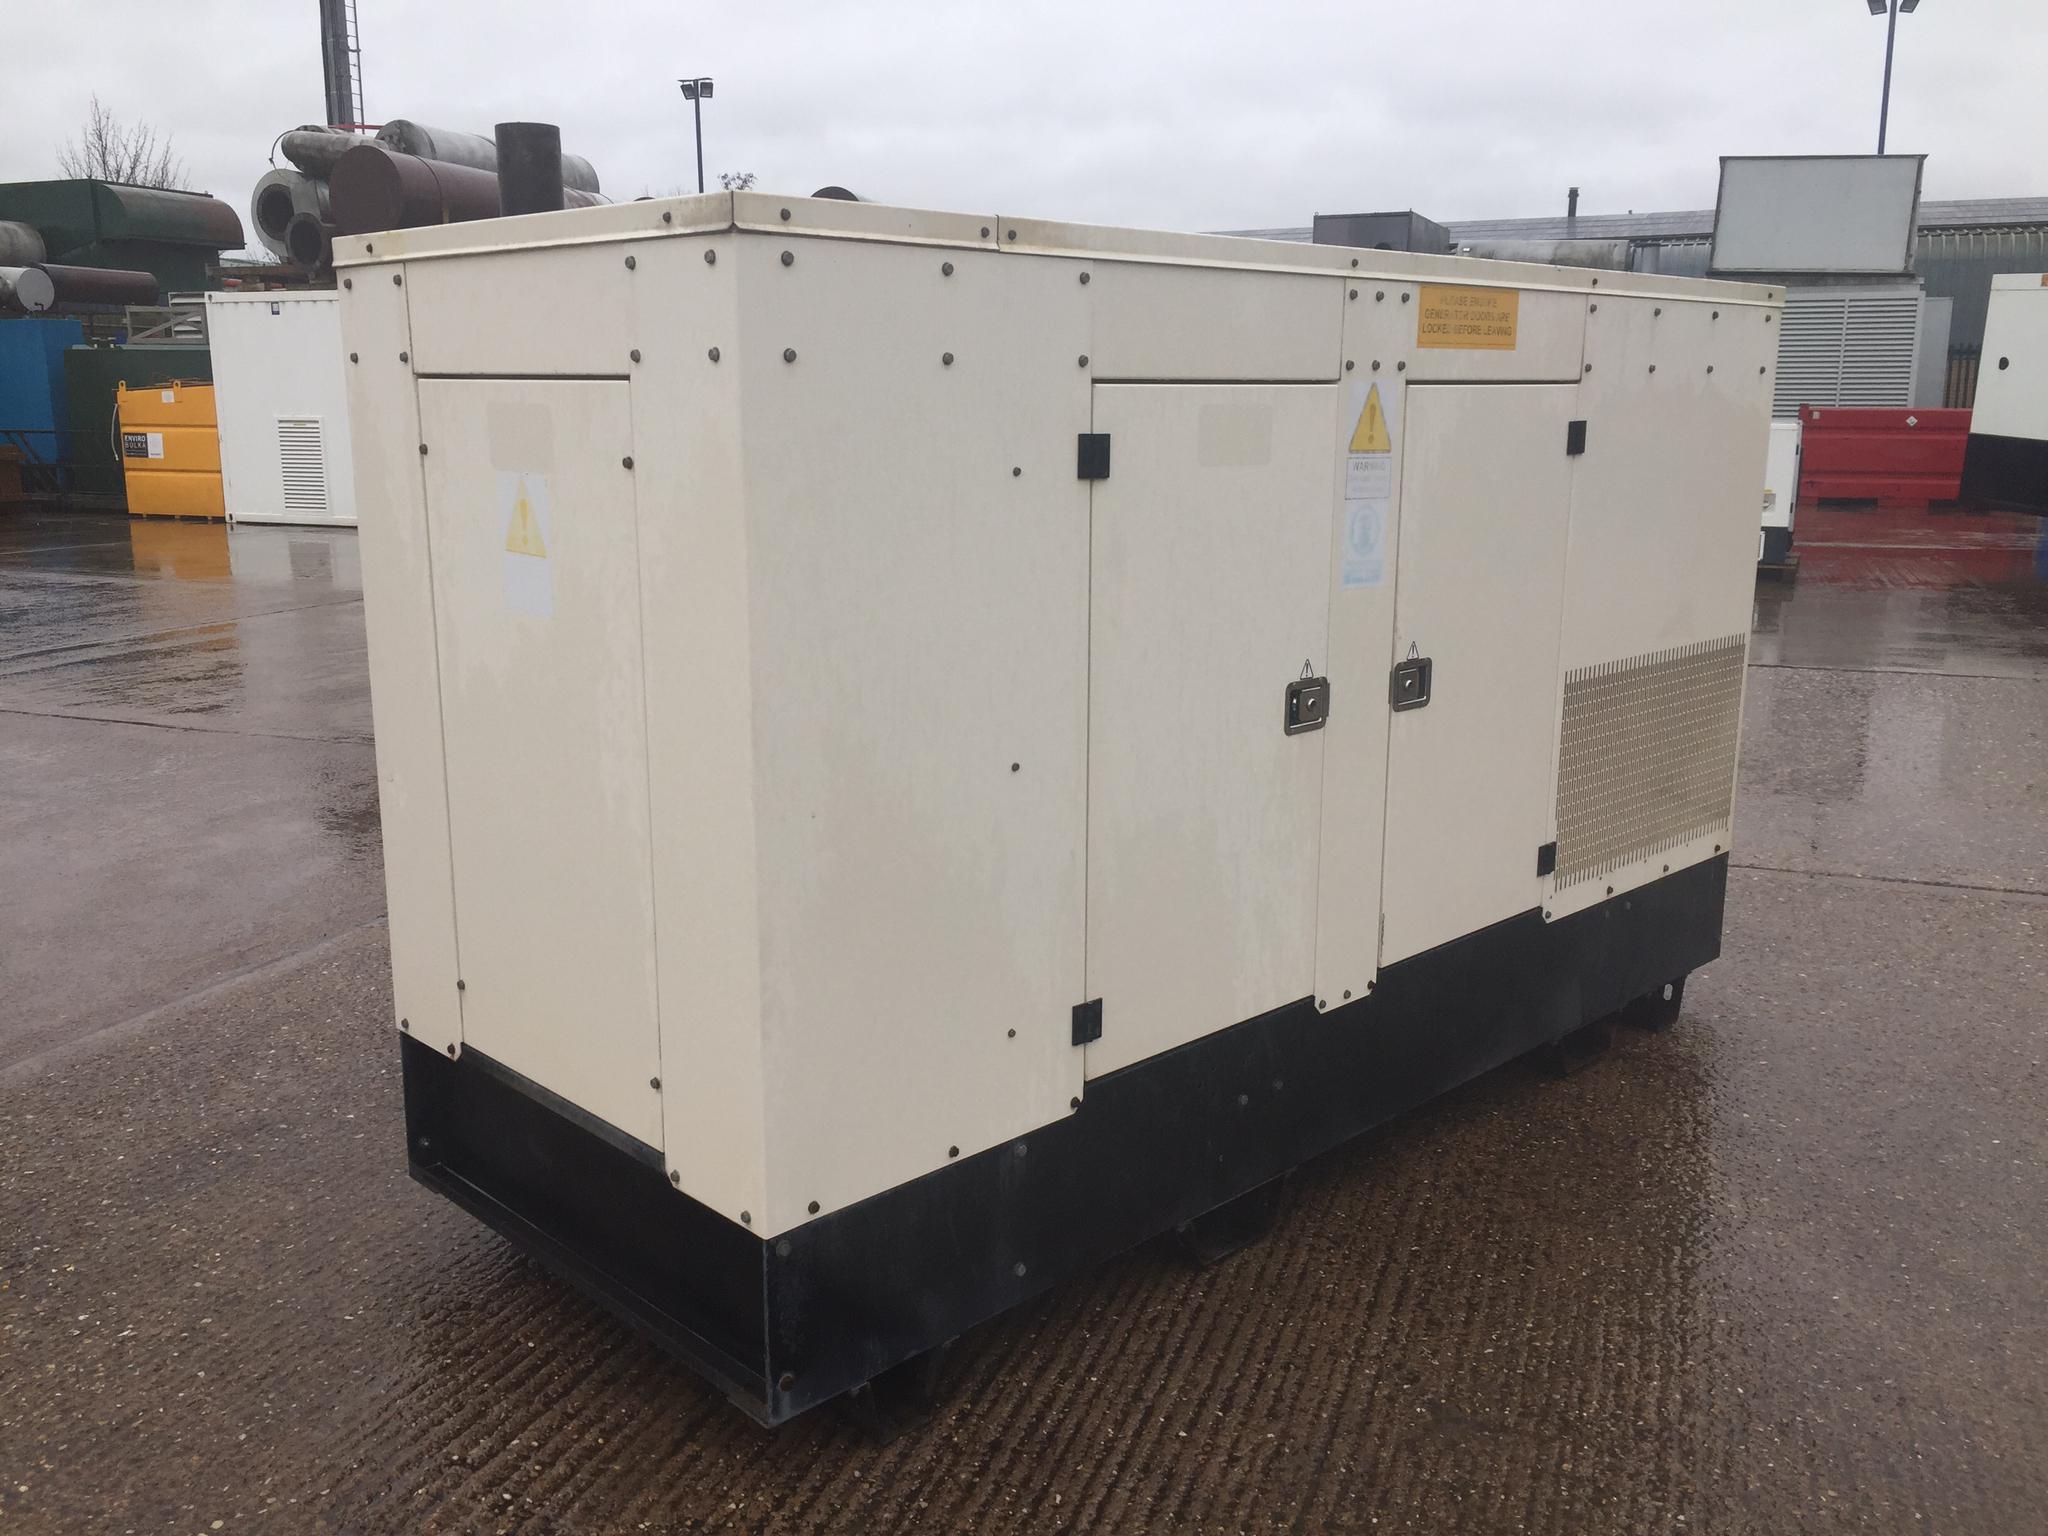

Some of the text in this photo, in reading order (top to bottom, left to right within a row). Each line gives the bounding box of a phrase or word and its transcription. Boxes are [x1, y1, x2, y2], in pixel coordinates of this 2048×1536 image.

[1469, 296, 1497, 308] ENRE
[1424, 308, 1469, 321] GENERTR
[1352, 460, 1385, 472] WARG
